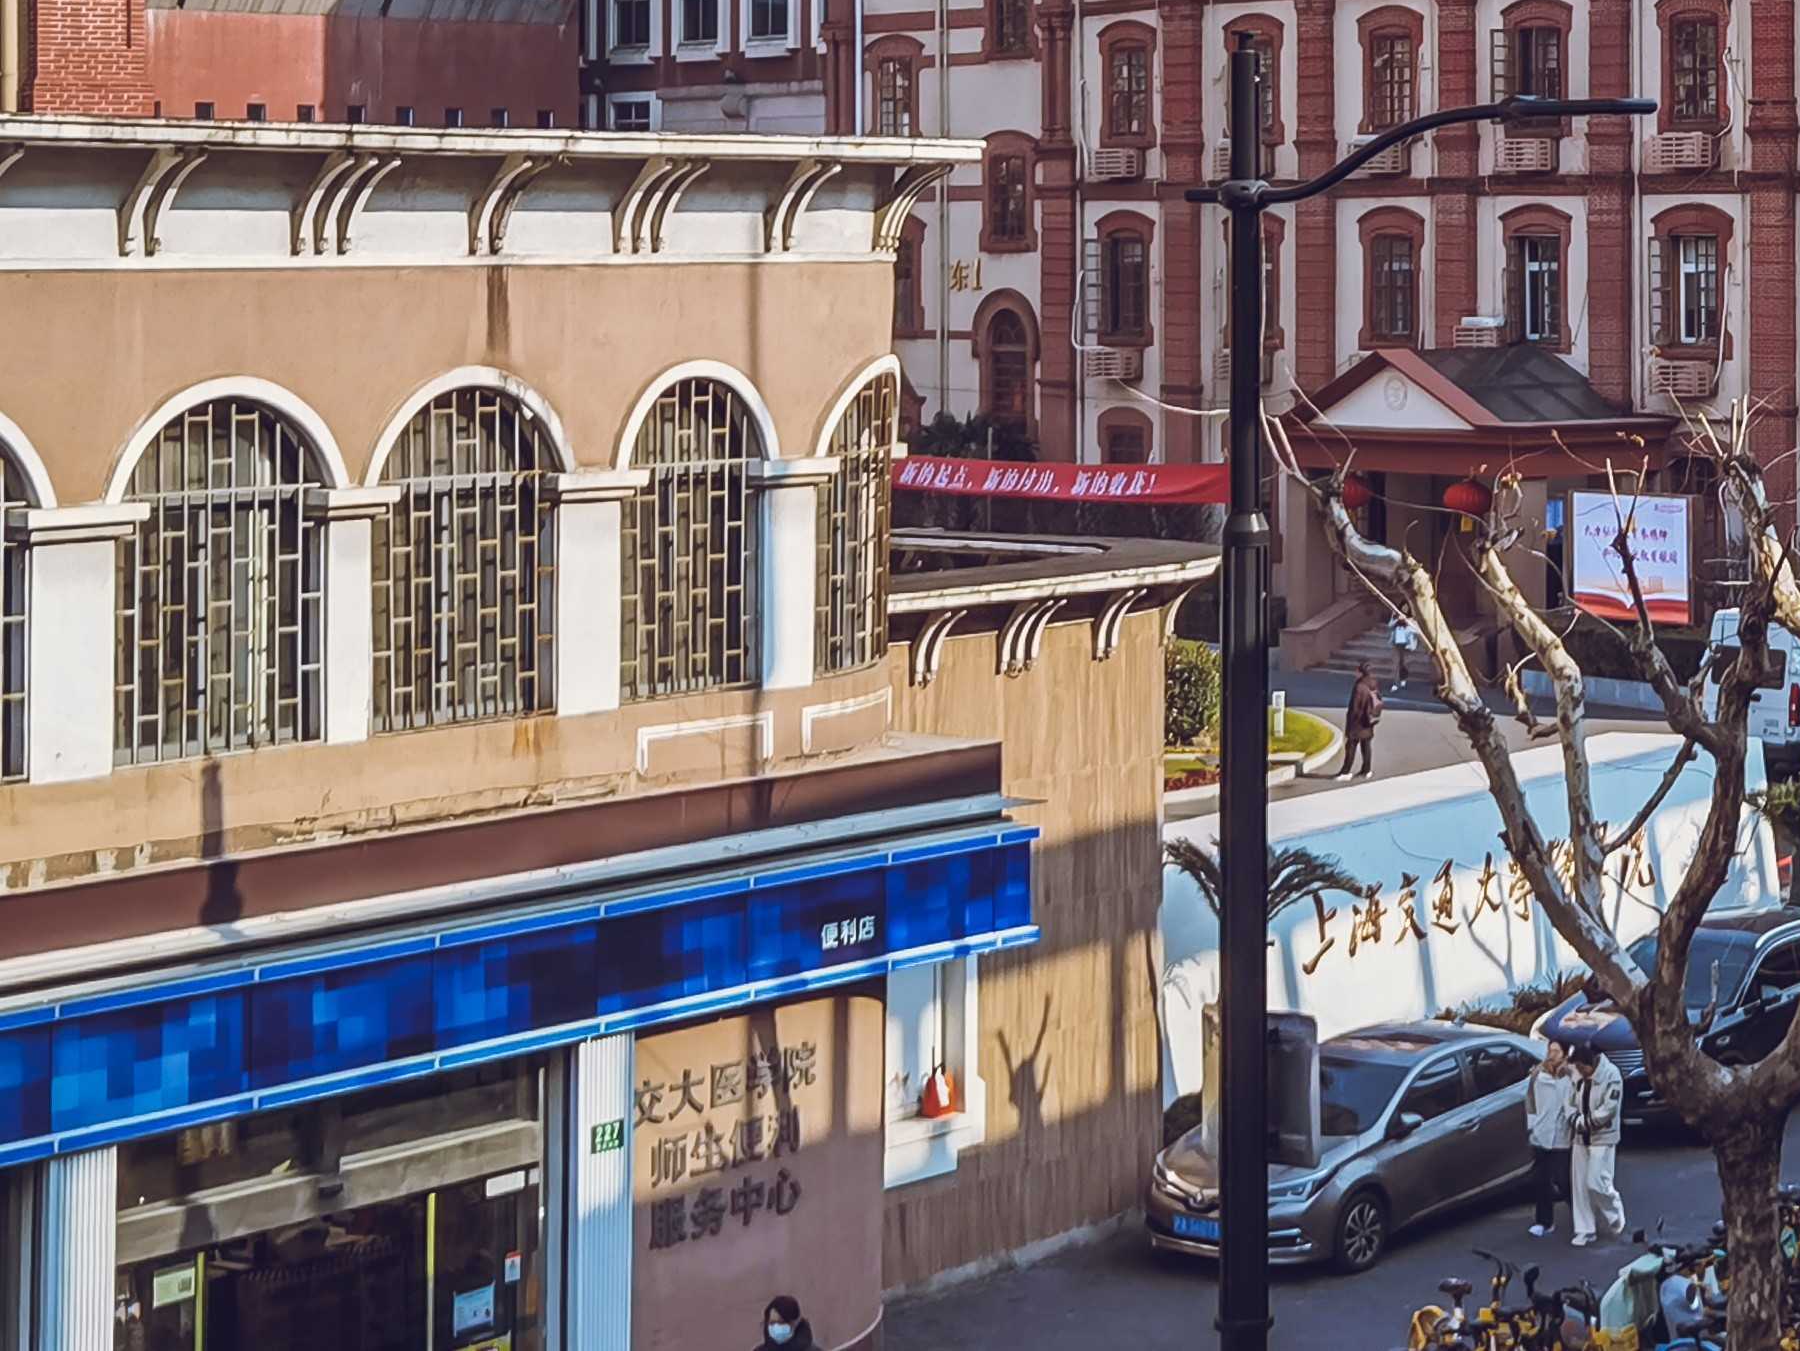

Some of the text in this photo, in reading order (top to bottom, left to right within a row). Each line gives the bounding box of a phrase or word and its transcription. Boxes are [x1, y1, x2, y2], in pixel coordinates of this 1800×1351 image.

[820, 915, 876, 951] 便利店
[633, 1041, 817, 1129] 交大医学院
[595, 1121, 620, 1142] 227
[650, 1104, 800, 1188] 师生便利
[649, 1167, 803, 1251] 服务中心
